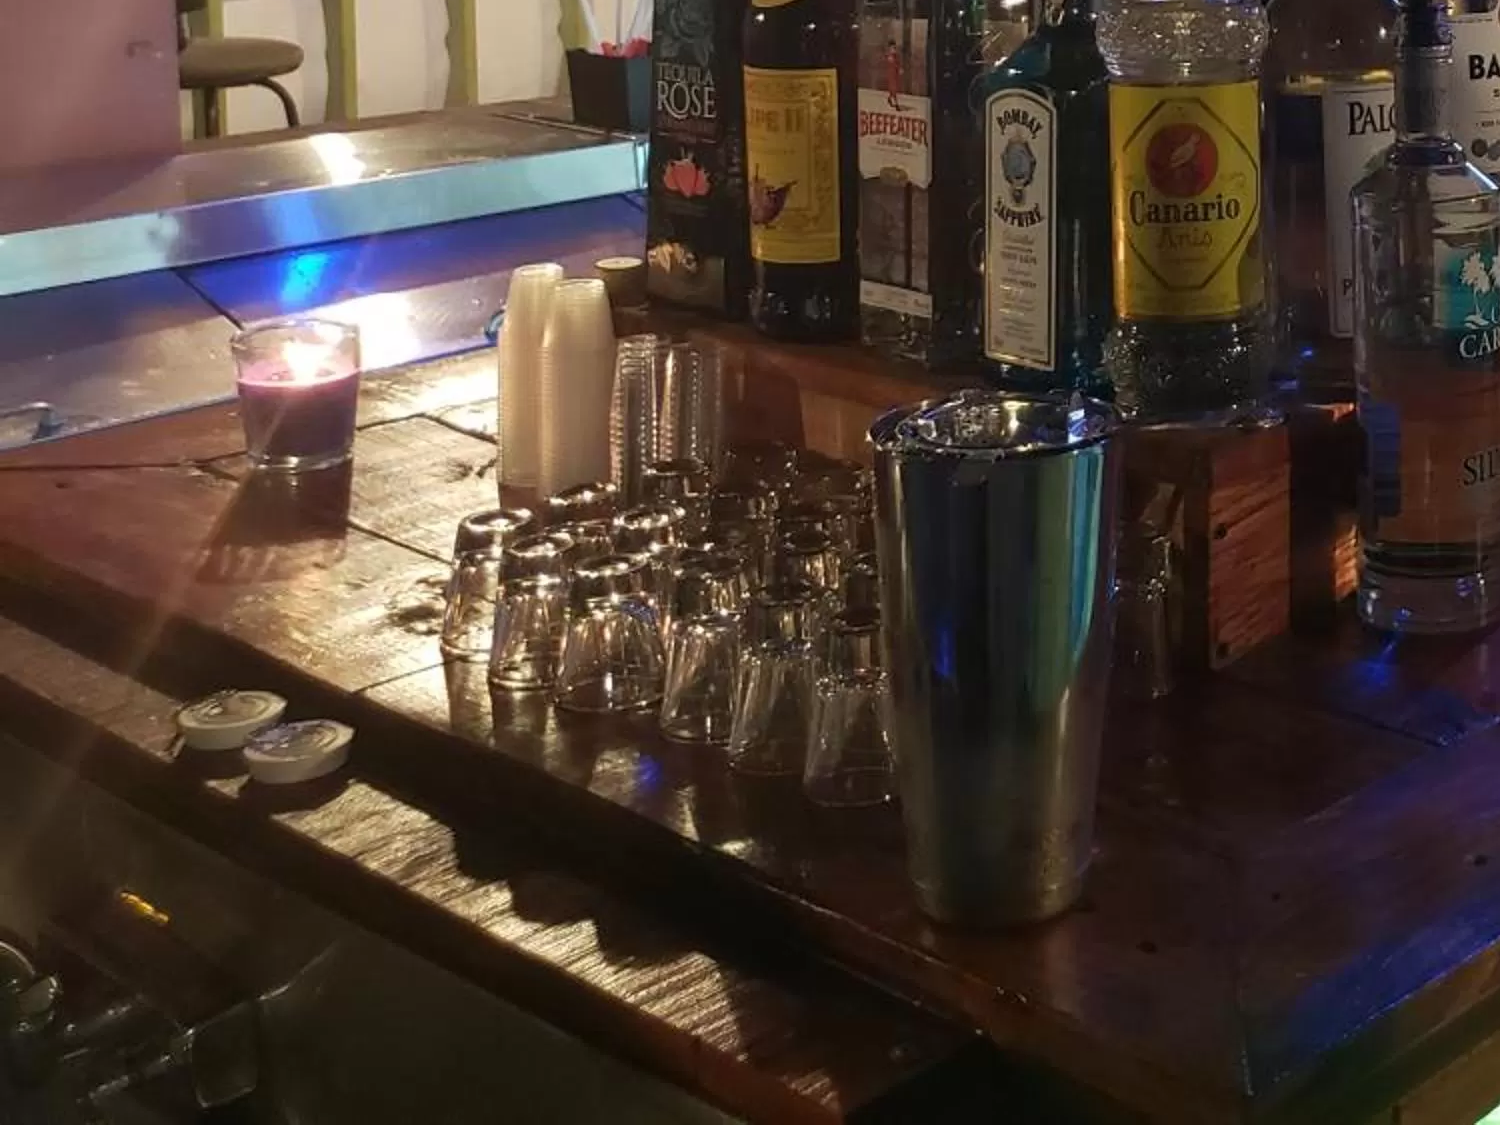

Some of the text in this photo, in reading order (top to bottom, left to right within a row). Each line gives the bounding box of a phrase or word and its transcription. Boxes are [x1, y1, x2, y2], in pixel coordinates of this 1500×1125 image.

[859, 109, 929, 148] BEEFEATER
[996, 108, 1043, 139] BOMBAY
[994, 197, 1046, 229] SAPPHIRE
[1129, 189, 1241, 226] Canario
